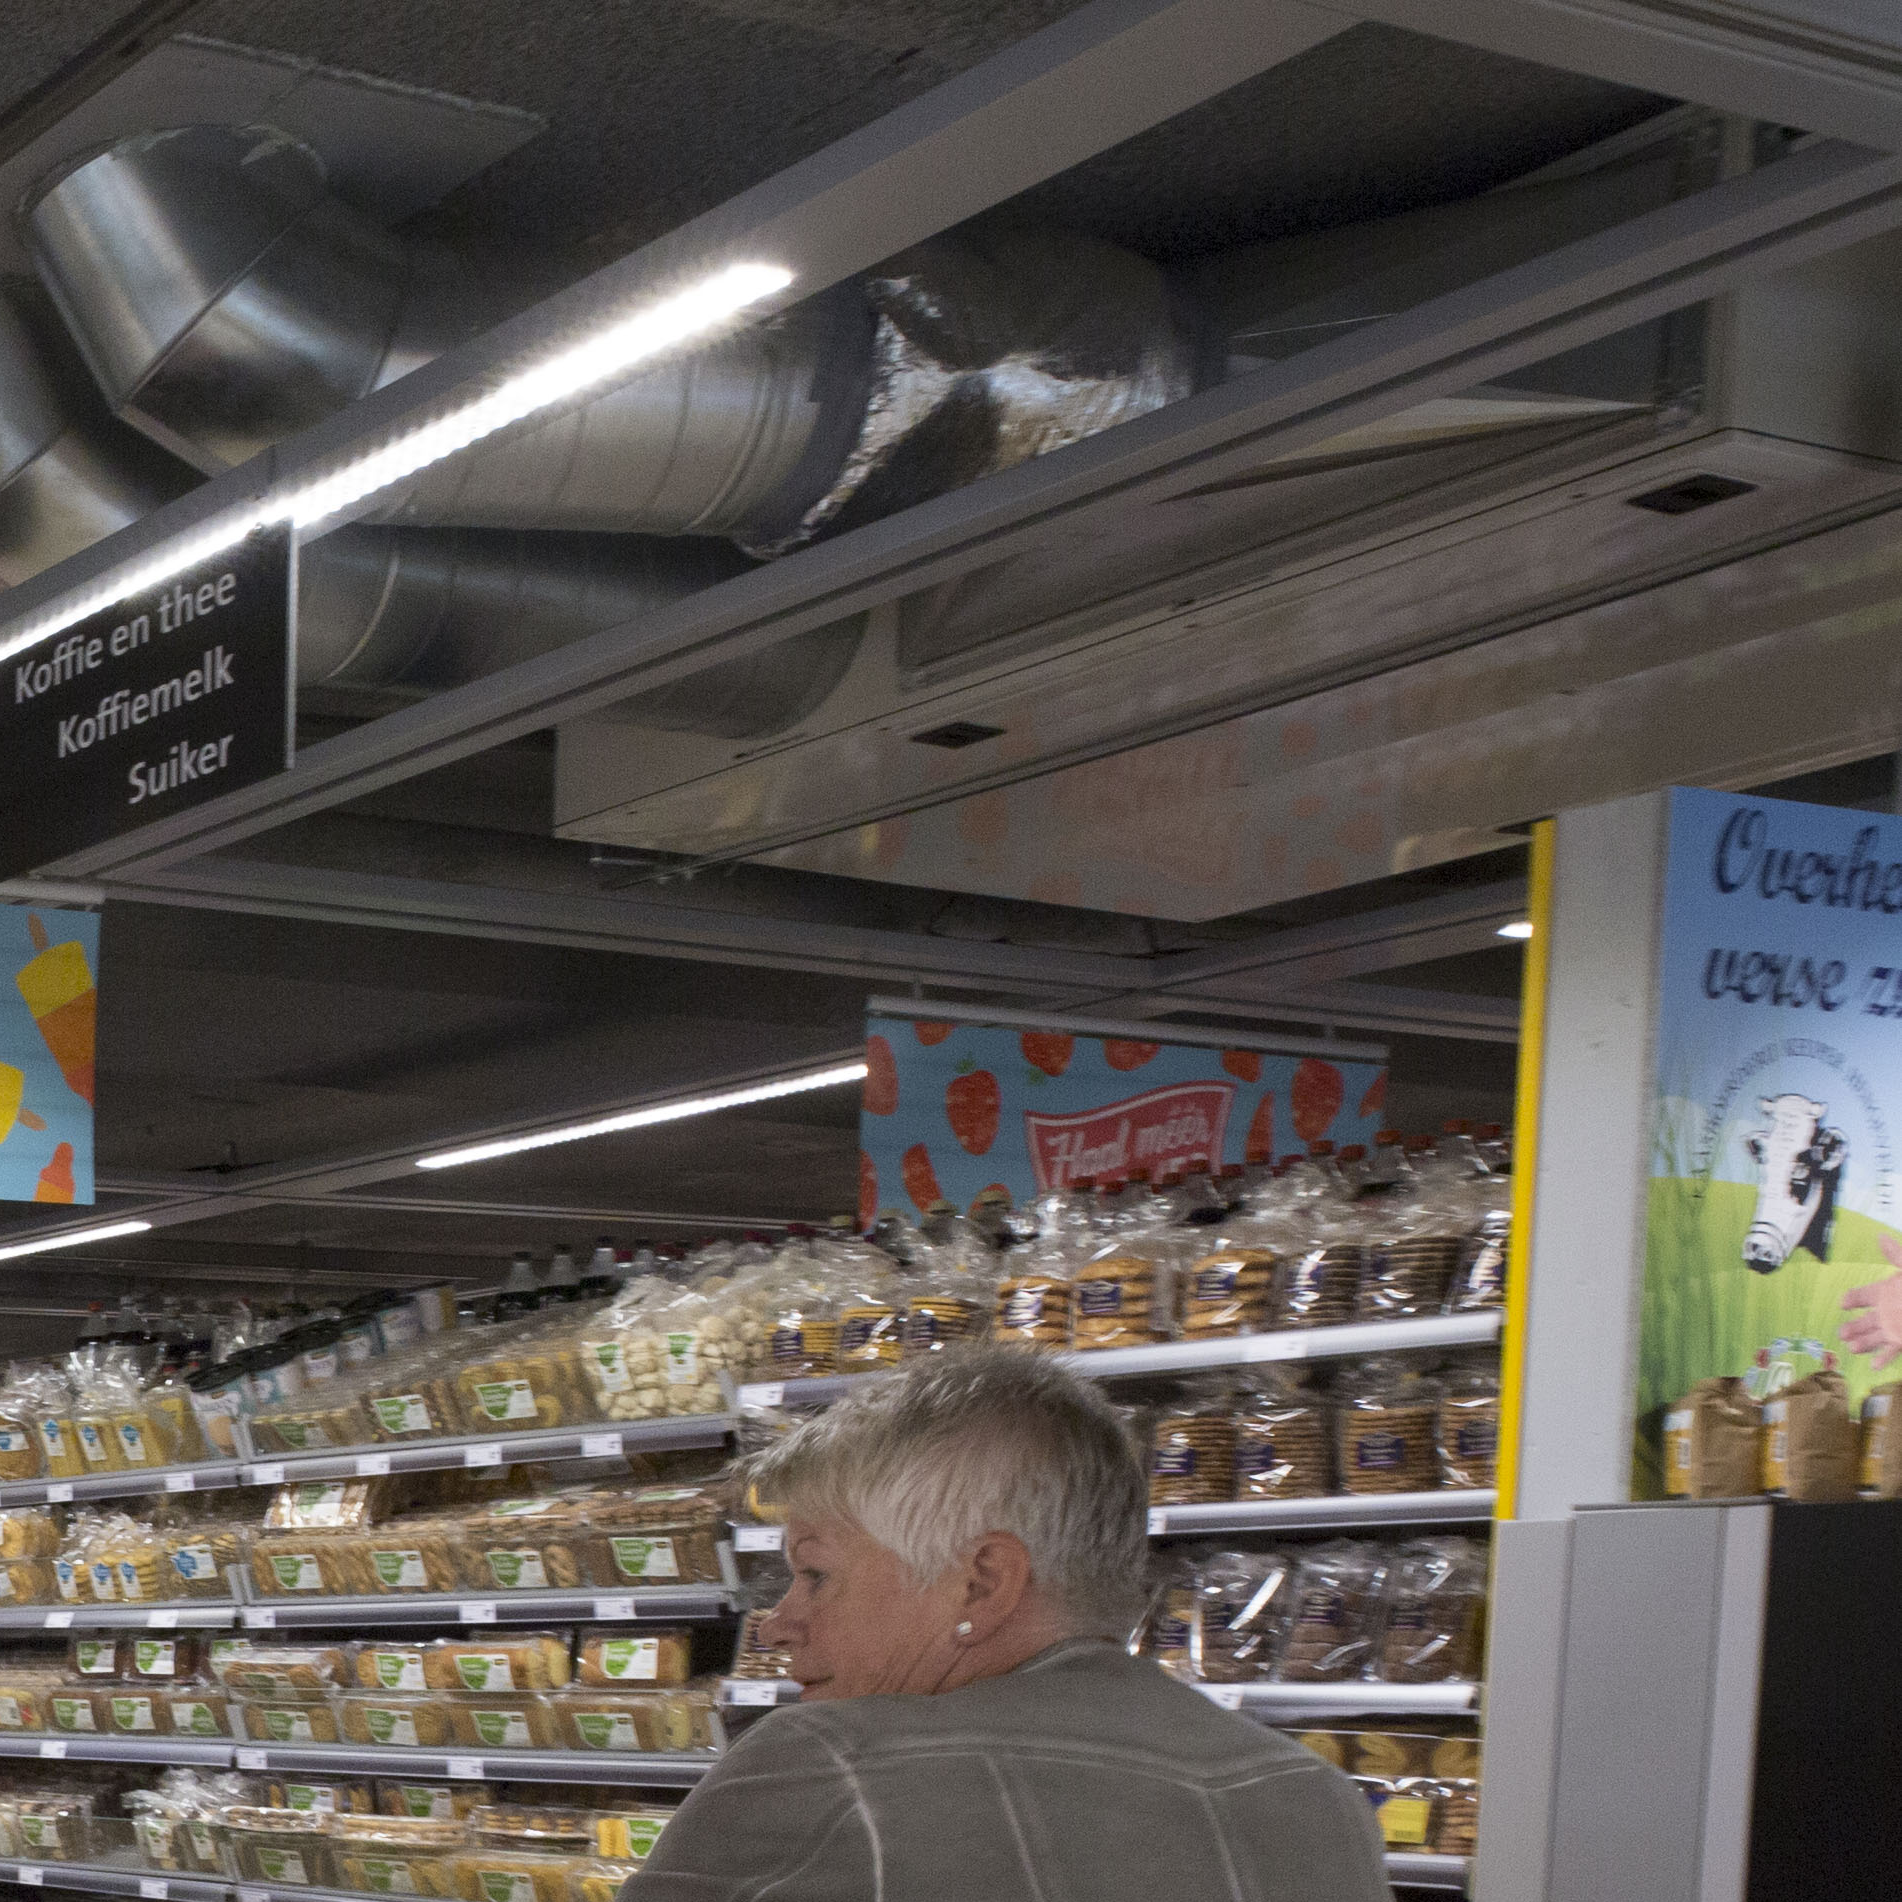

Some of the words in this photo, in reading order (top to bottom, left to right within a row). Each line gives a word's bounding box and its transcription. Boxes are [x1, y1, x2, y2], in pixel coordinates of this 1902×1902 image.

[14, 632, 103, 704] Koffie
[109, 615, 150, 657] en
[157, 571, 237, 634] thee
[57, 644, 235, 759] Koffiemelk
[128, 733, 235, 805] Suiker
[1704, 949, 1846, 1011] verse
